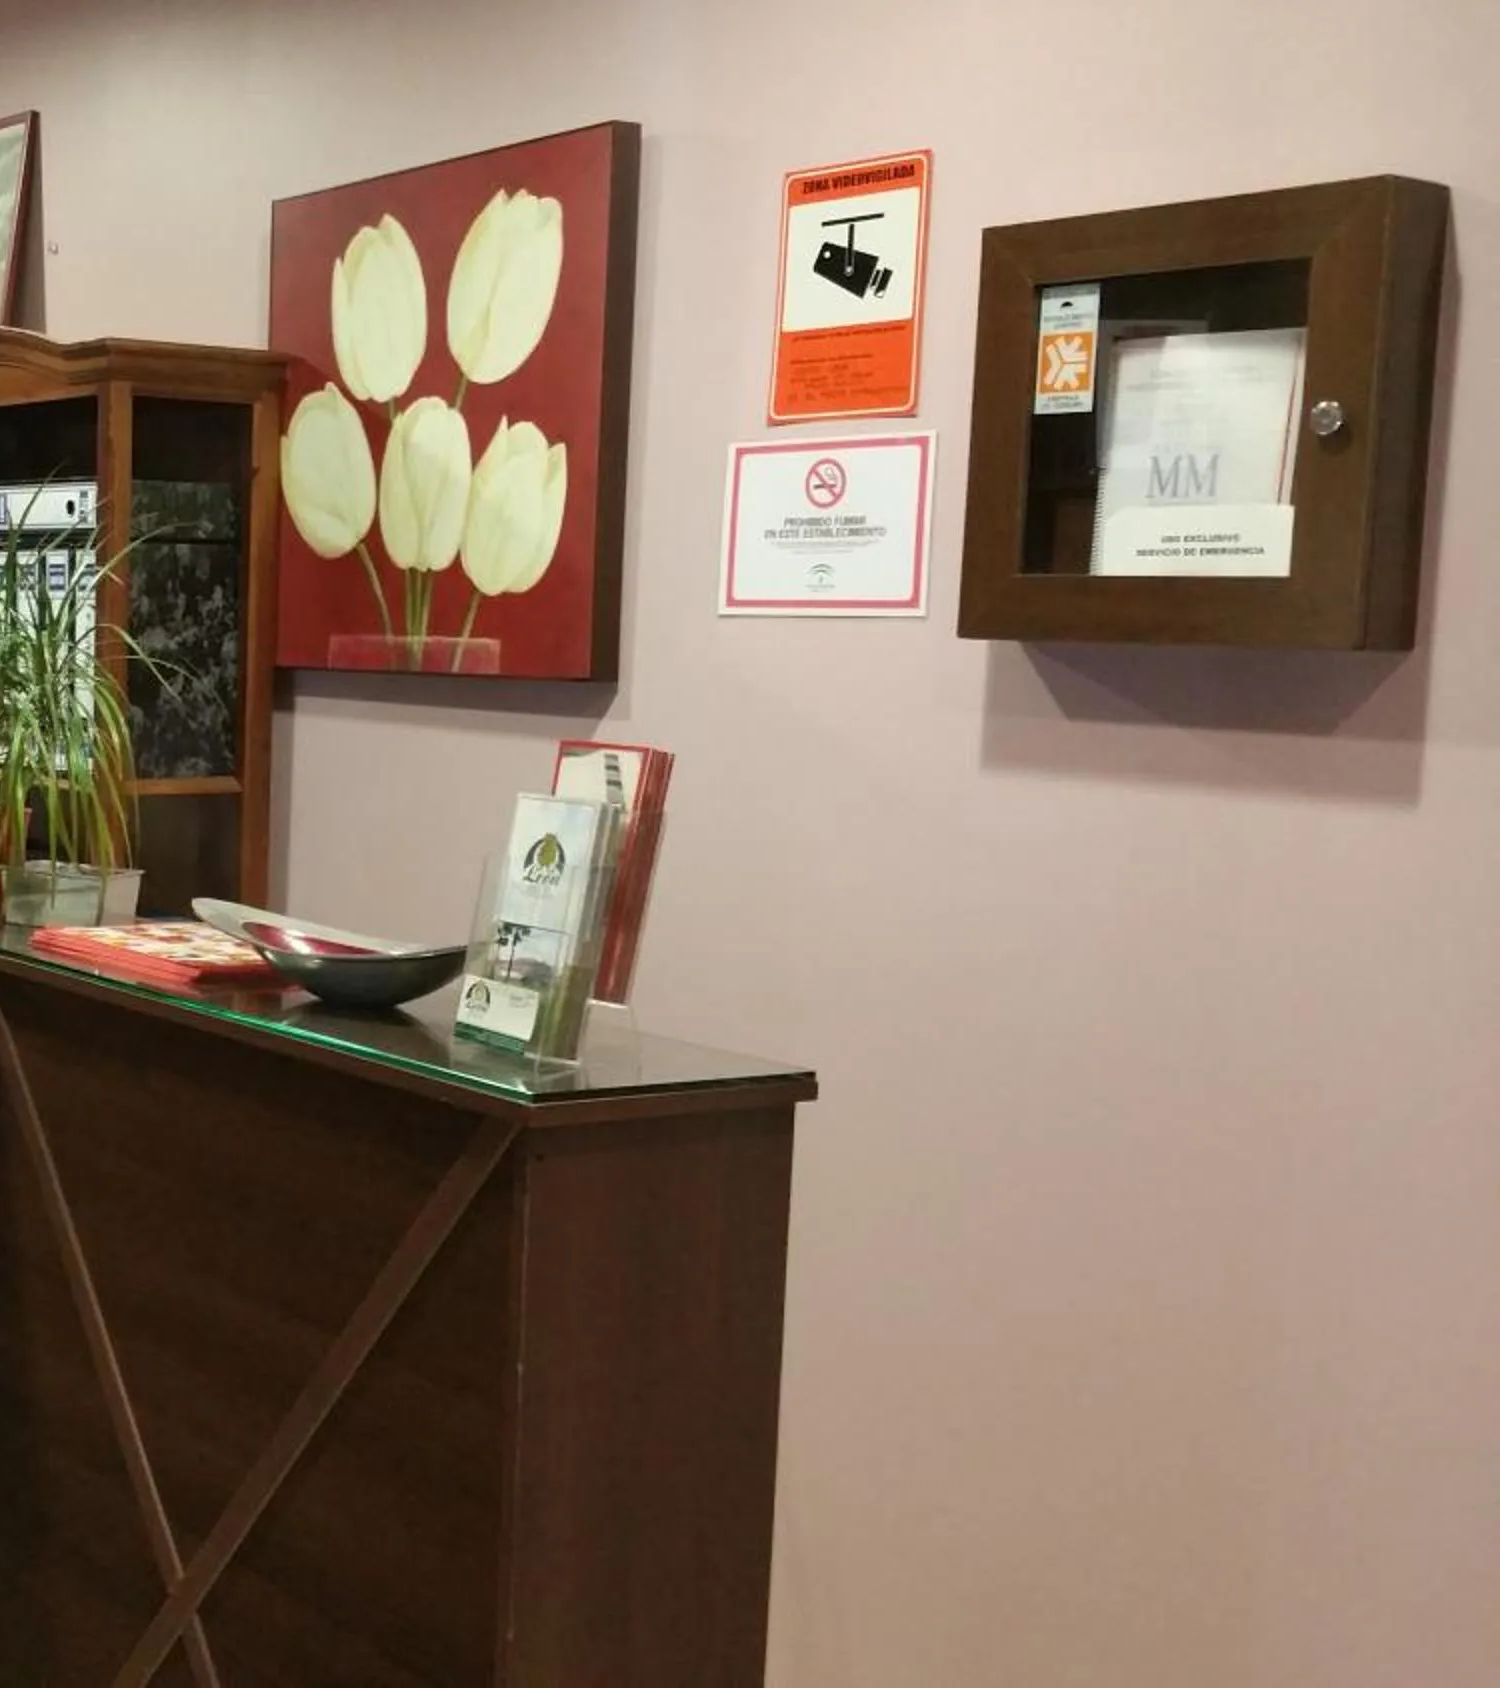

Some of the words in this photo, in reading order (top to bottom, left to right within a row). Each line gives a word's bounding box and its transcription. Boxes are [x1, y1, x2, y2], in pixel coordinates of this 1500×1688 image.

[802, 178, 831, 195] ZONA
[832, 163, 916, 191] VIDEOVIGILADA
[1145, 453, 1220, 499] MM
[783, 516, 833, 528] PROHIBIDO
